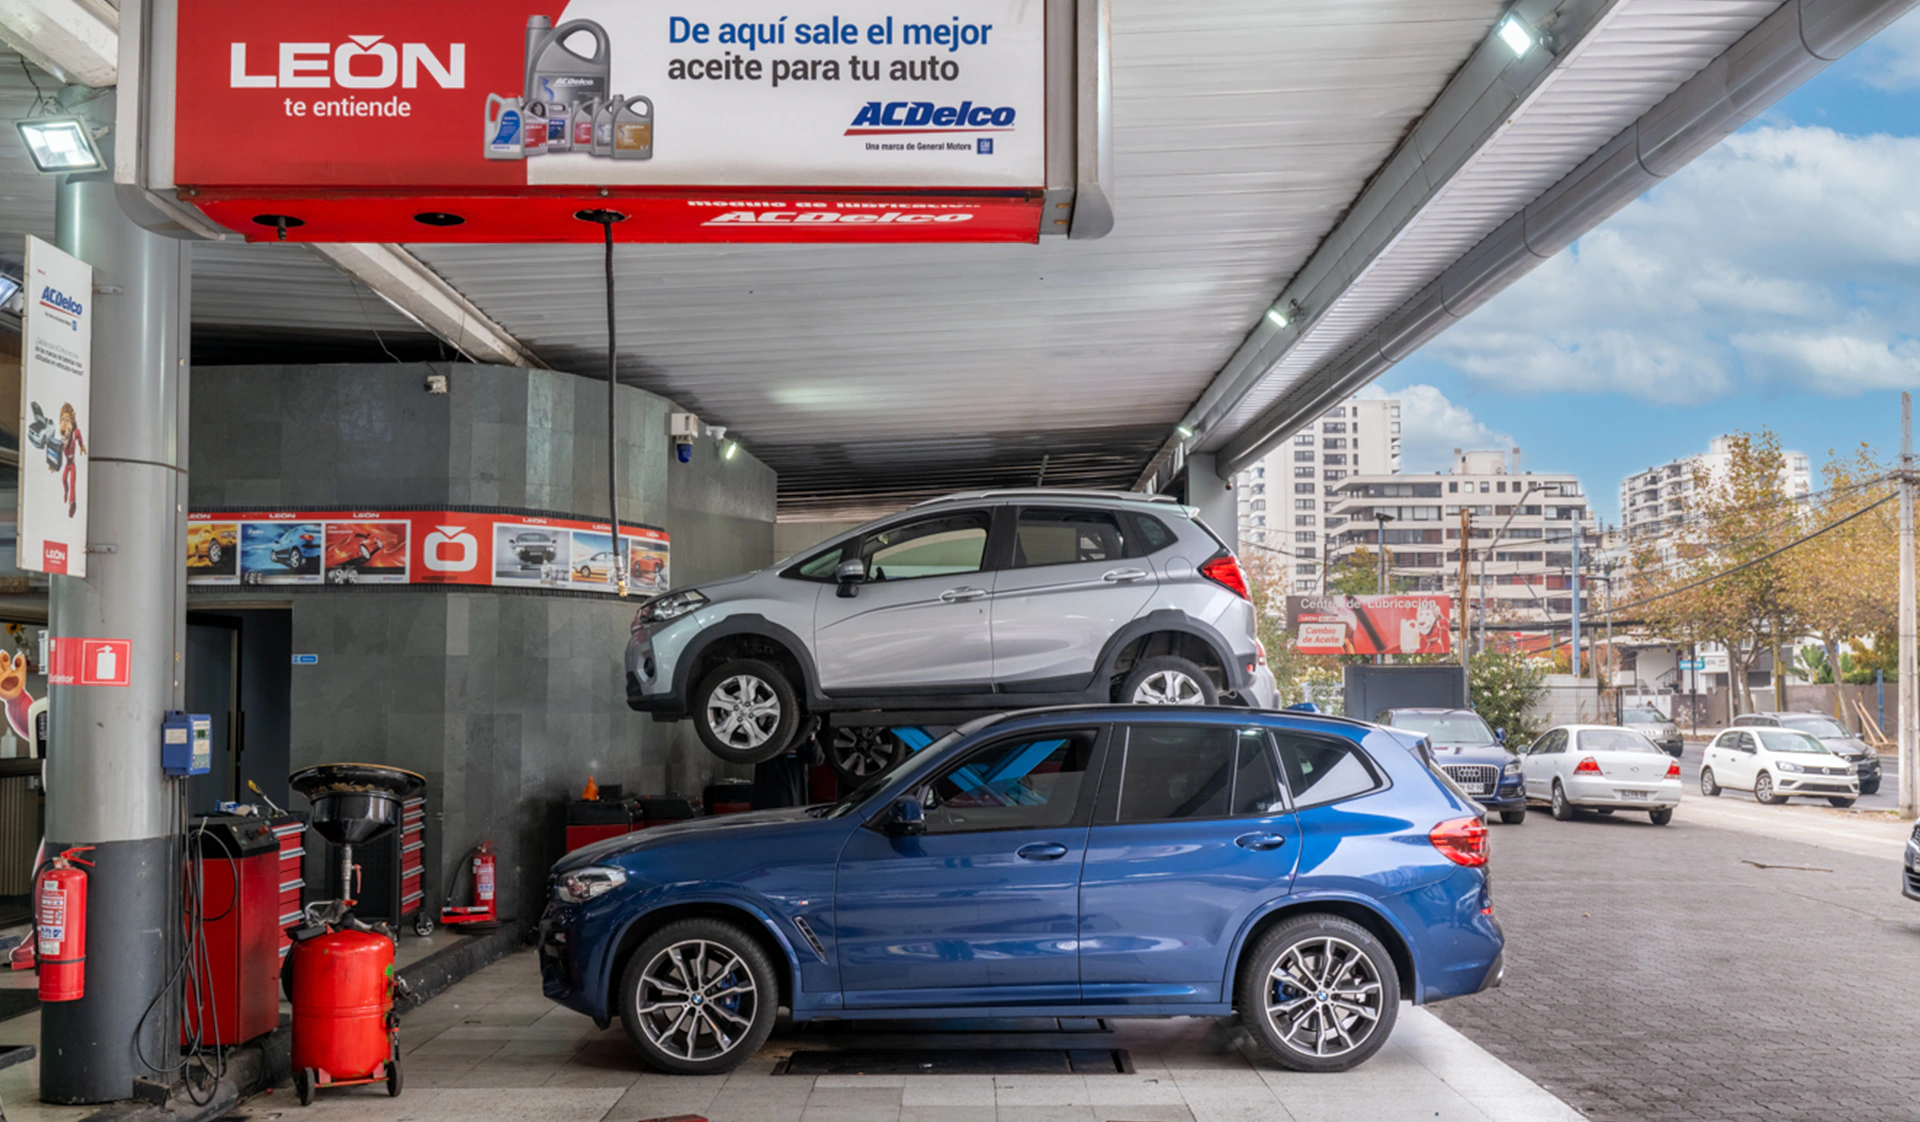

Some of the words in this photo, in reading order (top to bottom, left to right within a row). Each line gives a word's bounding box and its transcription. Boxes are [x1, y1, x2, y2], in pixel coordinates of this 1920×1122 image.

[670, 16, 709, 43] De
[718, 15, 789, 51] aquí
[796, 15, 858, 44] sale
[868, 15, 892, 44] el
[904, 16, 993, 52] mejor
[230, 35, 466, 89] LEÓN
[668, 51, 762, 80] aceite
[772, 57, 840, 88] para
[848, 54, 880, 80] tu
[889, 54, 960, 80] auto
[555, 77, 594, 86] ACDelco
[284, 97, 306, 117] te
[313, 96, 411, 117] entiende
[850, 101, 1016, 126] ACDelco
[865, 142, 880, 150] Una
[906, 142, 915, 150] de
[917, 142, 945, 150] General
[947, 142, 972, 150] Motors
[704, 211, 974, 224] ACDelco
[41, 285, 83, 316] ACDelco
[1346, 598, 1361, 609] de
[1367, 597, 1437, 611] Lubricación
[1305, 626, 1337, 635] Cambio
[1302, 636, 1313, 644] de
[1314, 636, 1341, 644] Aceite
